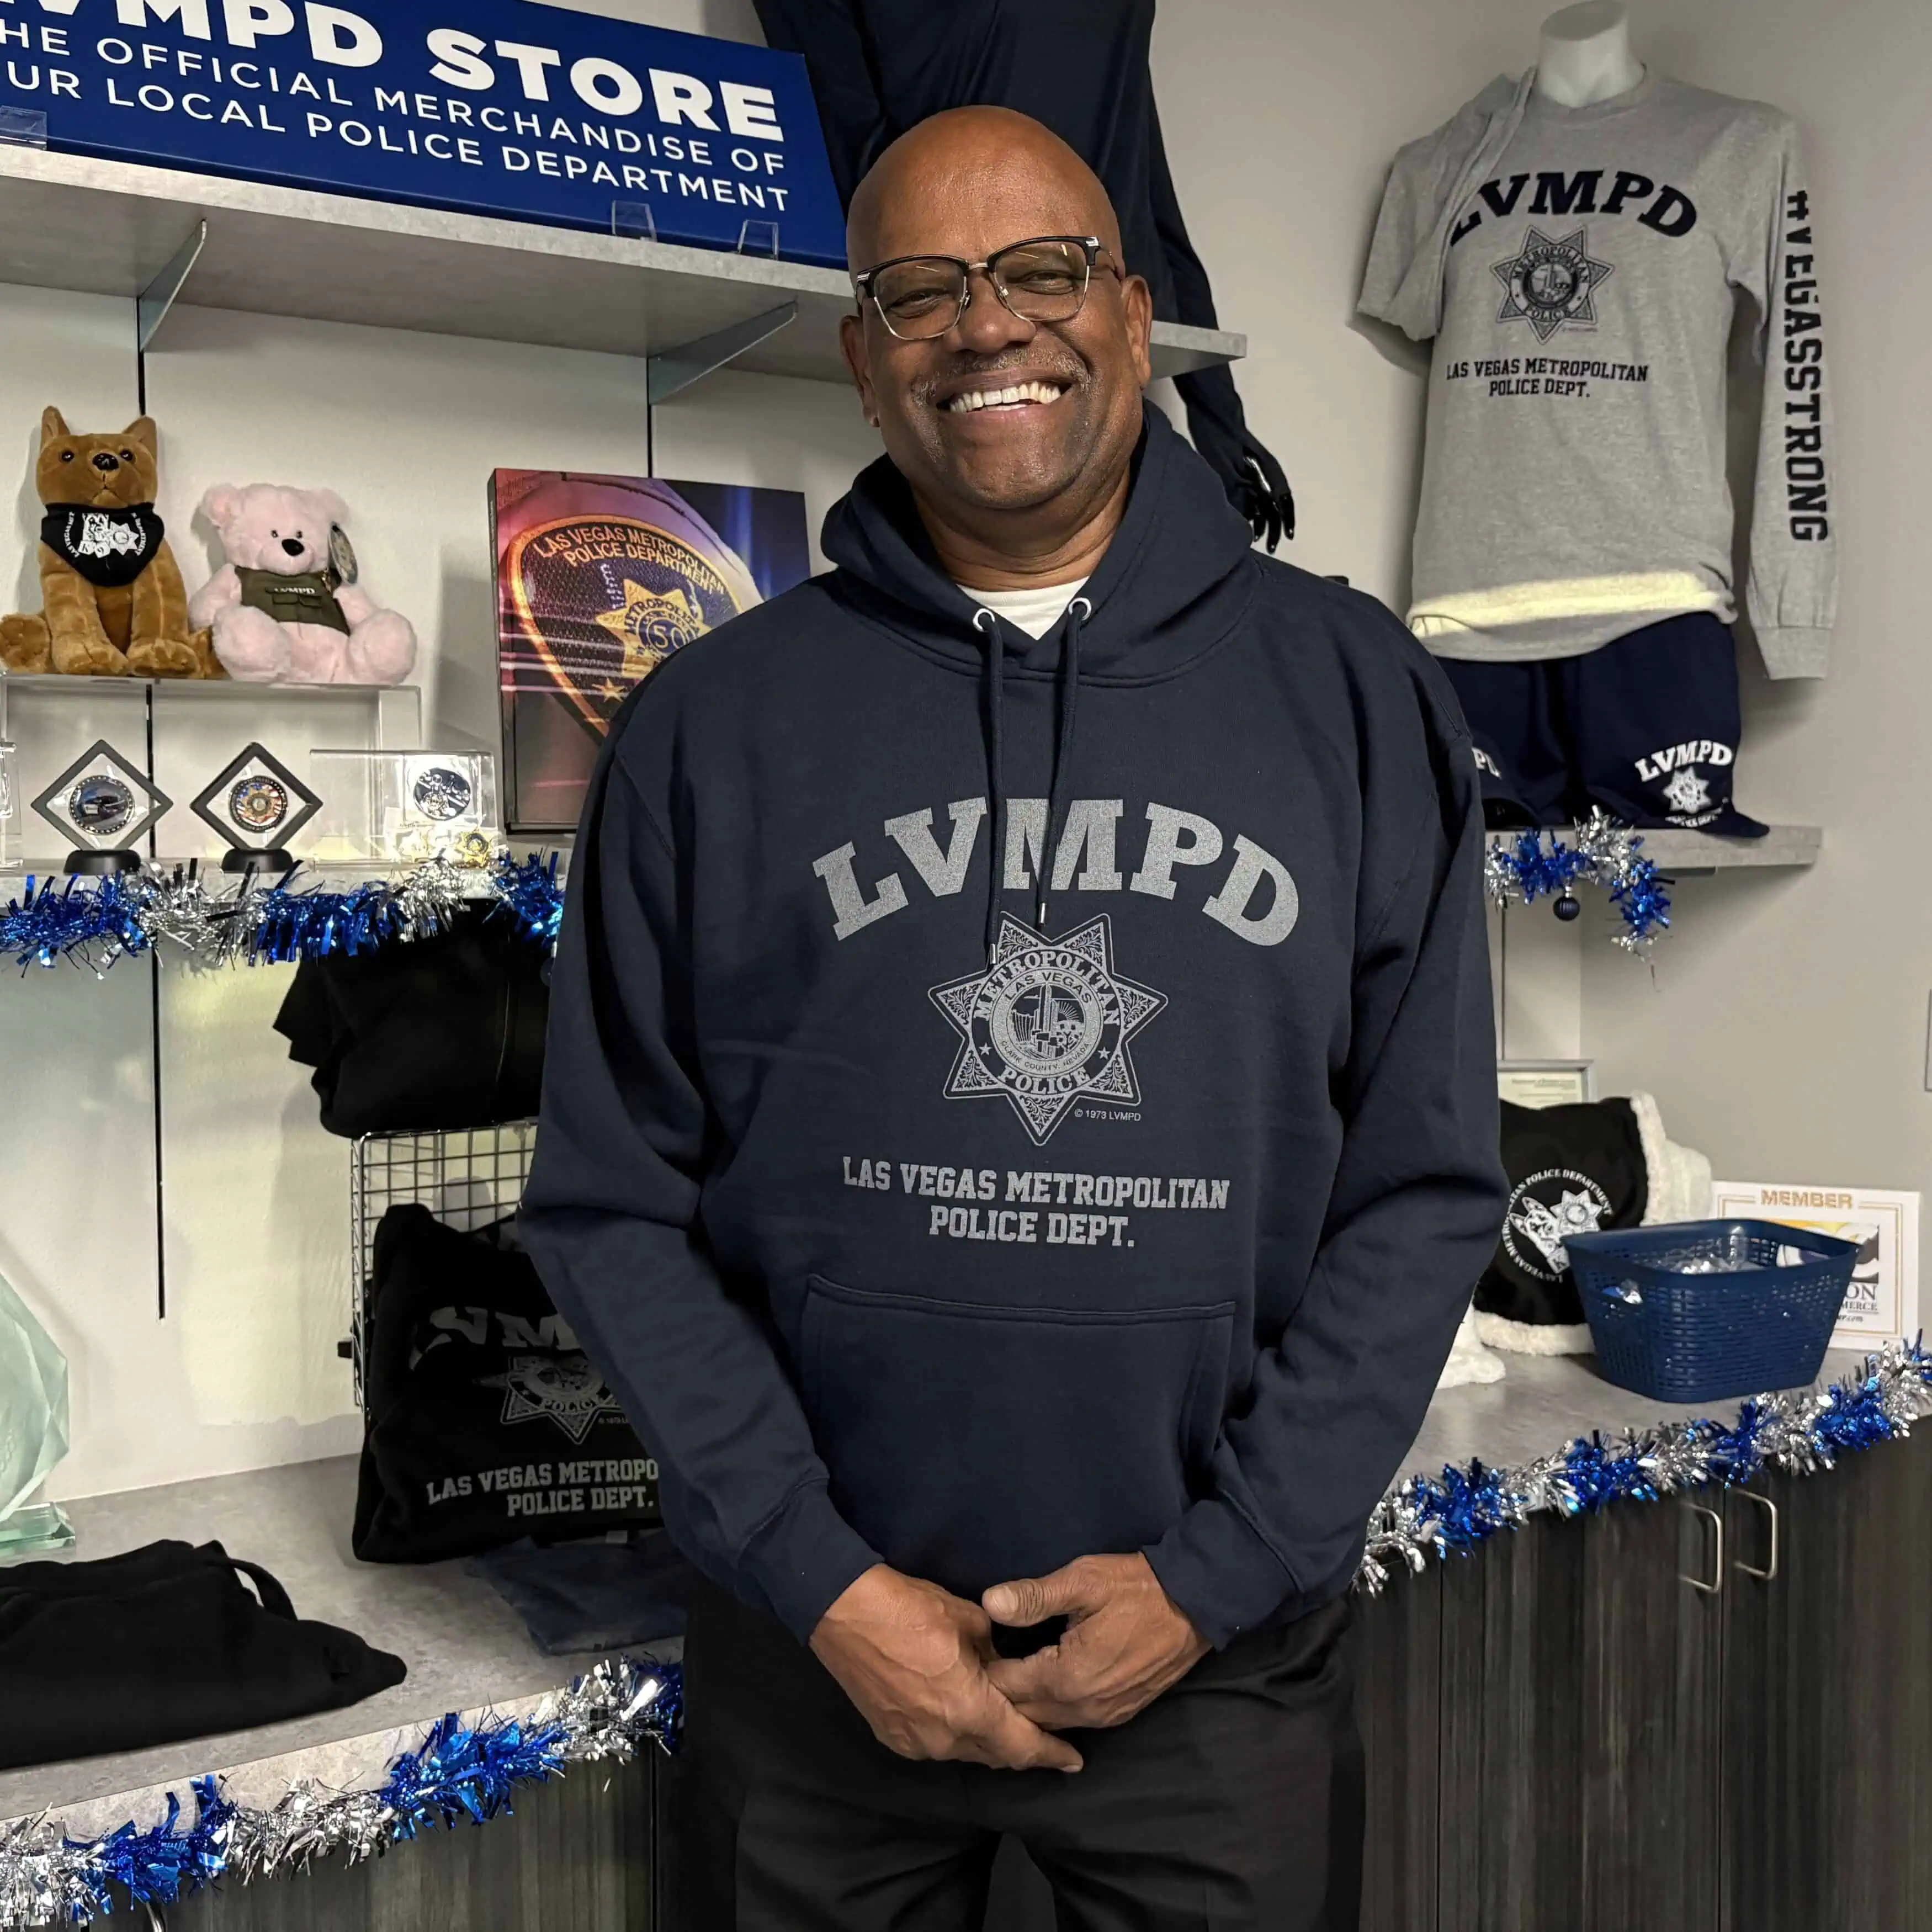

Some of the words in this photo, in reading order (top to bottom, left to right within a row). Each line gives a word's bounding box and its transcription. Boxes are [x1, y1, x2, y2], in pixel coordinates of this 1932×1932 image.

[0, 0, 383, 67] MPD
[427, 29, 784, 142] STORE
[97, 38, 353, 107] OFFICIAL
[375, 87, 713, 166] MERCHANDISE
[731, 148, 784, 176] OF
[7, 61, 82, 99] UR
[107, 78, 286, 133] LOCAL
[307, 113, 484, 166] POLICE
[502, 146, 789, 211] DEPARTMENT
[1446, 362, 1469, 380] LAS
[1473, 358, 1520, 377] VEGAS
[1525, 357, 1649, 382] METROPOLITAN
[1489, 378, 1541, 397] POLICE
[1544, 378, 1590, 398] DEPT.
[1784, 190, 1828, 542] #VEGASSTRONG
[533, 532, 572, 558] LAS
[567, 525, 626, 545] VEGAS
[627, 527, 726, 595] METROPOLITAN
[564, 542, 624, 567] POLICE
[627, 543, 714, 595] DEPARTMENT
[1635, 740, 1733, 782] LVMPD
[813, 797, 1299, 946] LVMPD
[974, 951, 1121, 1026] METROPOLITAN
[1004, 974, 1036, 1001] LAS
[1042, 972, 1092, 1004] VEGAS
[999, 1065, 1091, 1094] POLICE
[1086, 1110, 1107, 1119] 1973
[1109, 1111, 1142, 1121] LVMPD
[842, 1156, 891, 1191] LAS
[900, 1163, 997, 1201] VEGAS
[1005, 1170, 1230, 1210] METROPOLITAN
[1525, 1168, 1562, 1186] POLICE
[1562, 1169, 1614, 1216] DEPARTMENT
[1761, 1189, 1854, 1209] MEMBER
[928, 1206, 1038, 1244] POLICE
[1046, 1212, 1135, 1248] DEPT.
[426, 1477, 473, 1505] LAS
[478, 1463, 553, 1492] VEGAS
[558, 1458, 659, 1483] METROPO
[507, 1489, 585, 1517] POLICE
[590, 1485, 655, 1510] DEPT.
